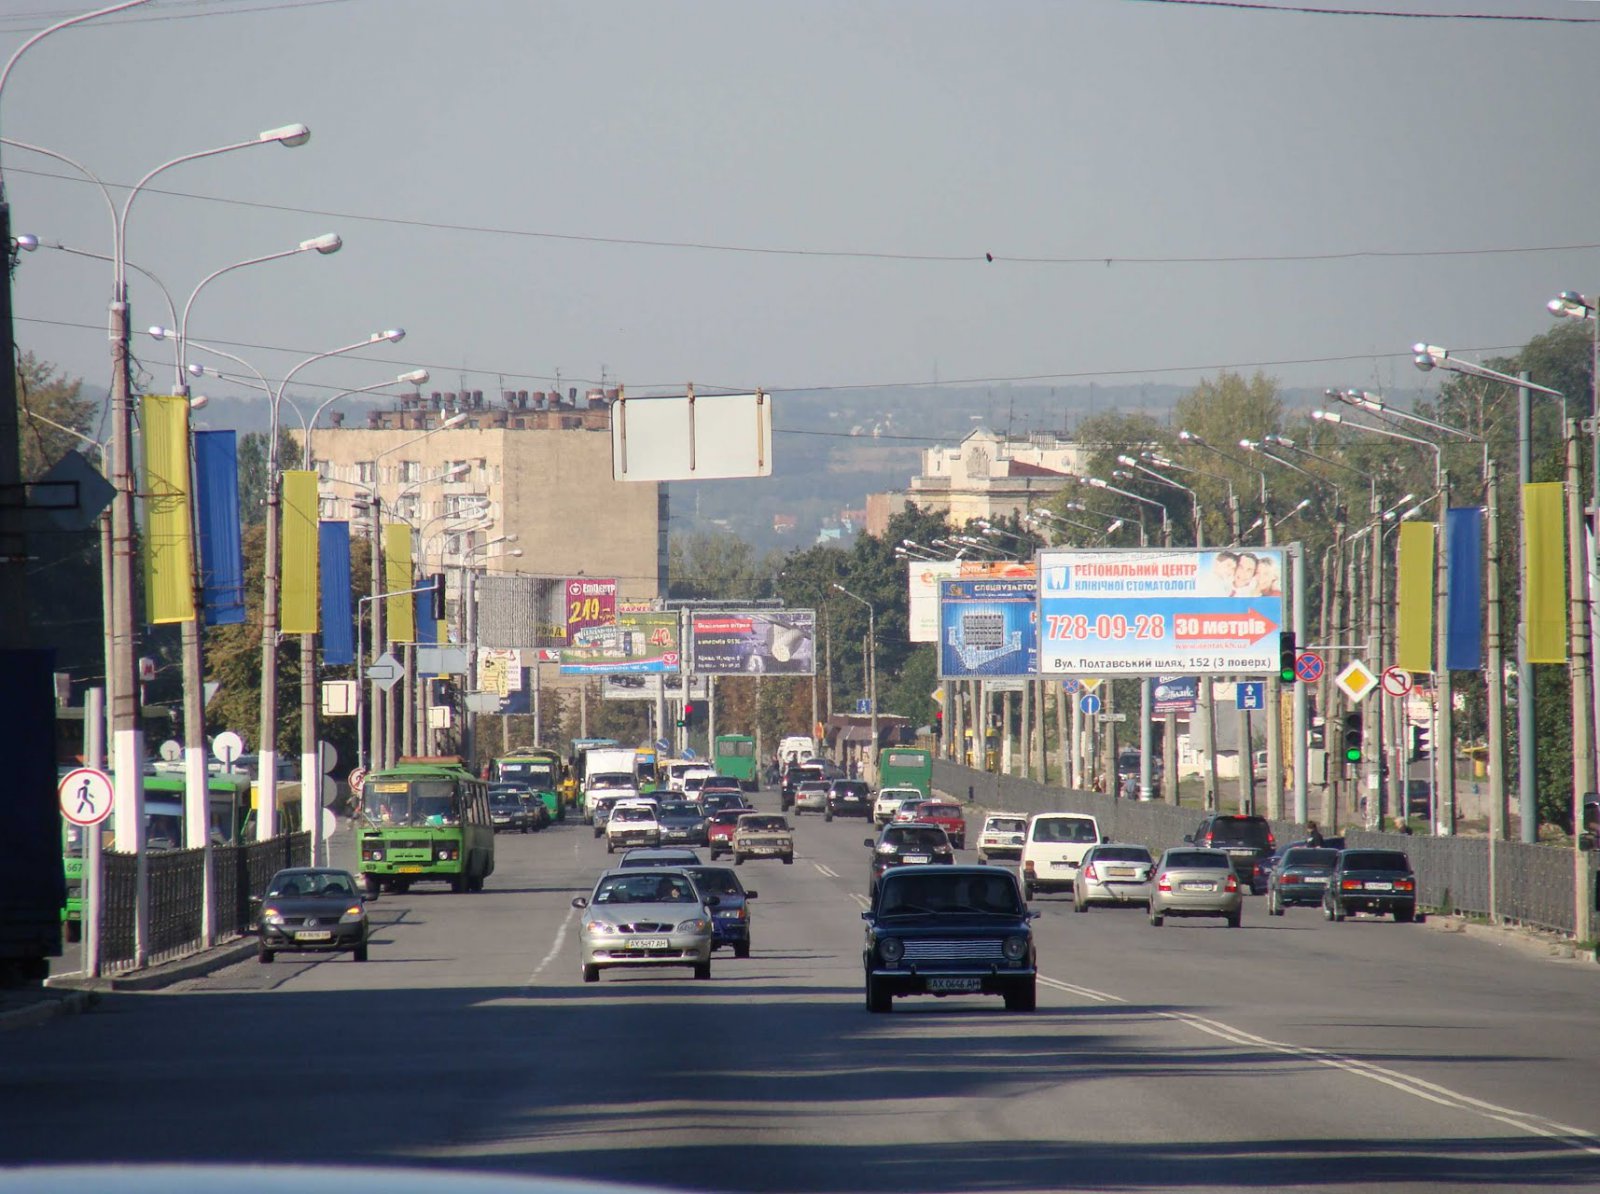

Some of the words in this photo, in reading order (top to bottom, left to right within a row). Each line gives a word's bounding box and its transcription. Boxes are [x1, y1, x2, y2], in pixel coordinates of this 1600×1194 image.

[1162, 564, 1197, 577] ЦЕНТР
[1046, 614, 1165, 640] 728-09-28
[1175, 618, 1200, 635] 30
[1202, 618, 1267, 636] метрів
[1054, 658, 1076, 670] Вул.
[1079, 658, 1152, 668] Полтавський
[1154, 660, 1186, 669] шлях,
[1189, 658, 1210, 667] 152
[1213, 657, 1225, 668] (3
[1227, 657, 1272, 669] поверх)
